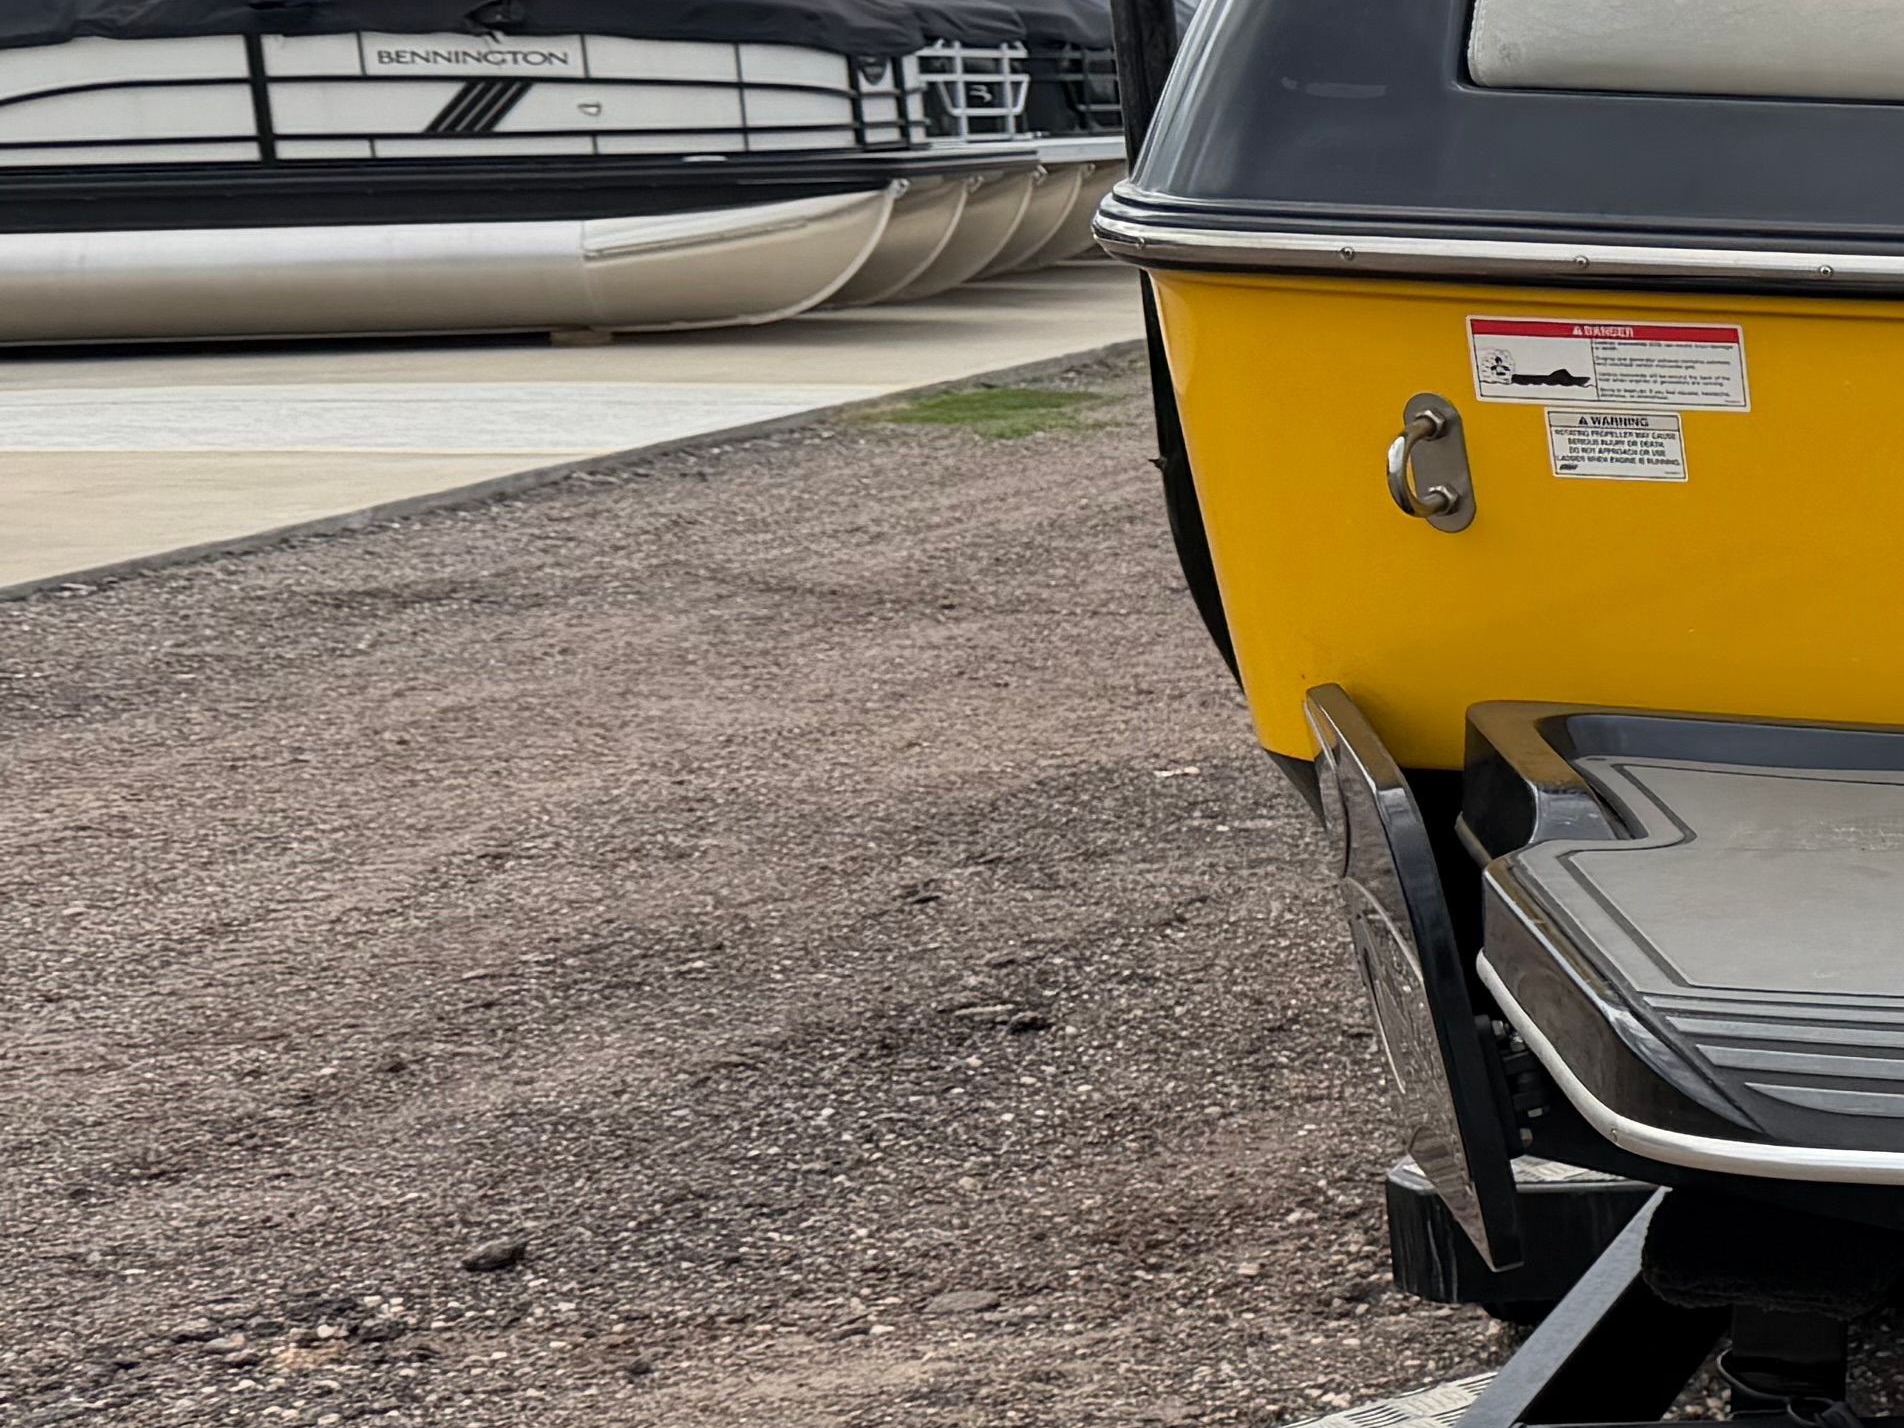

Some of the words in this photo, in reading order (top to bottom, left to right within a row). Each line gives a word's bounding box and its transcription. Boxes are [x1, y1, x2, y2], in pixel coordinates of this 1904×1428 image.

[377, 50, 569, 66] BENNINGTON
[1585, 326, 1633, 338] DANGER
[1590, 416, 1649, 427] WARNING
